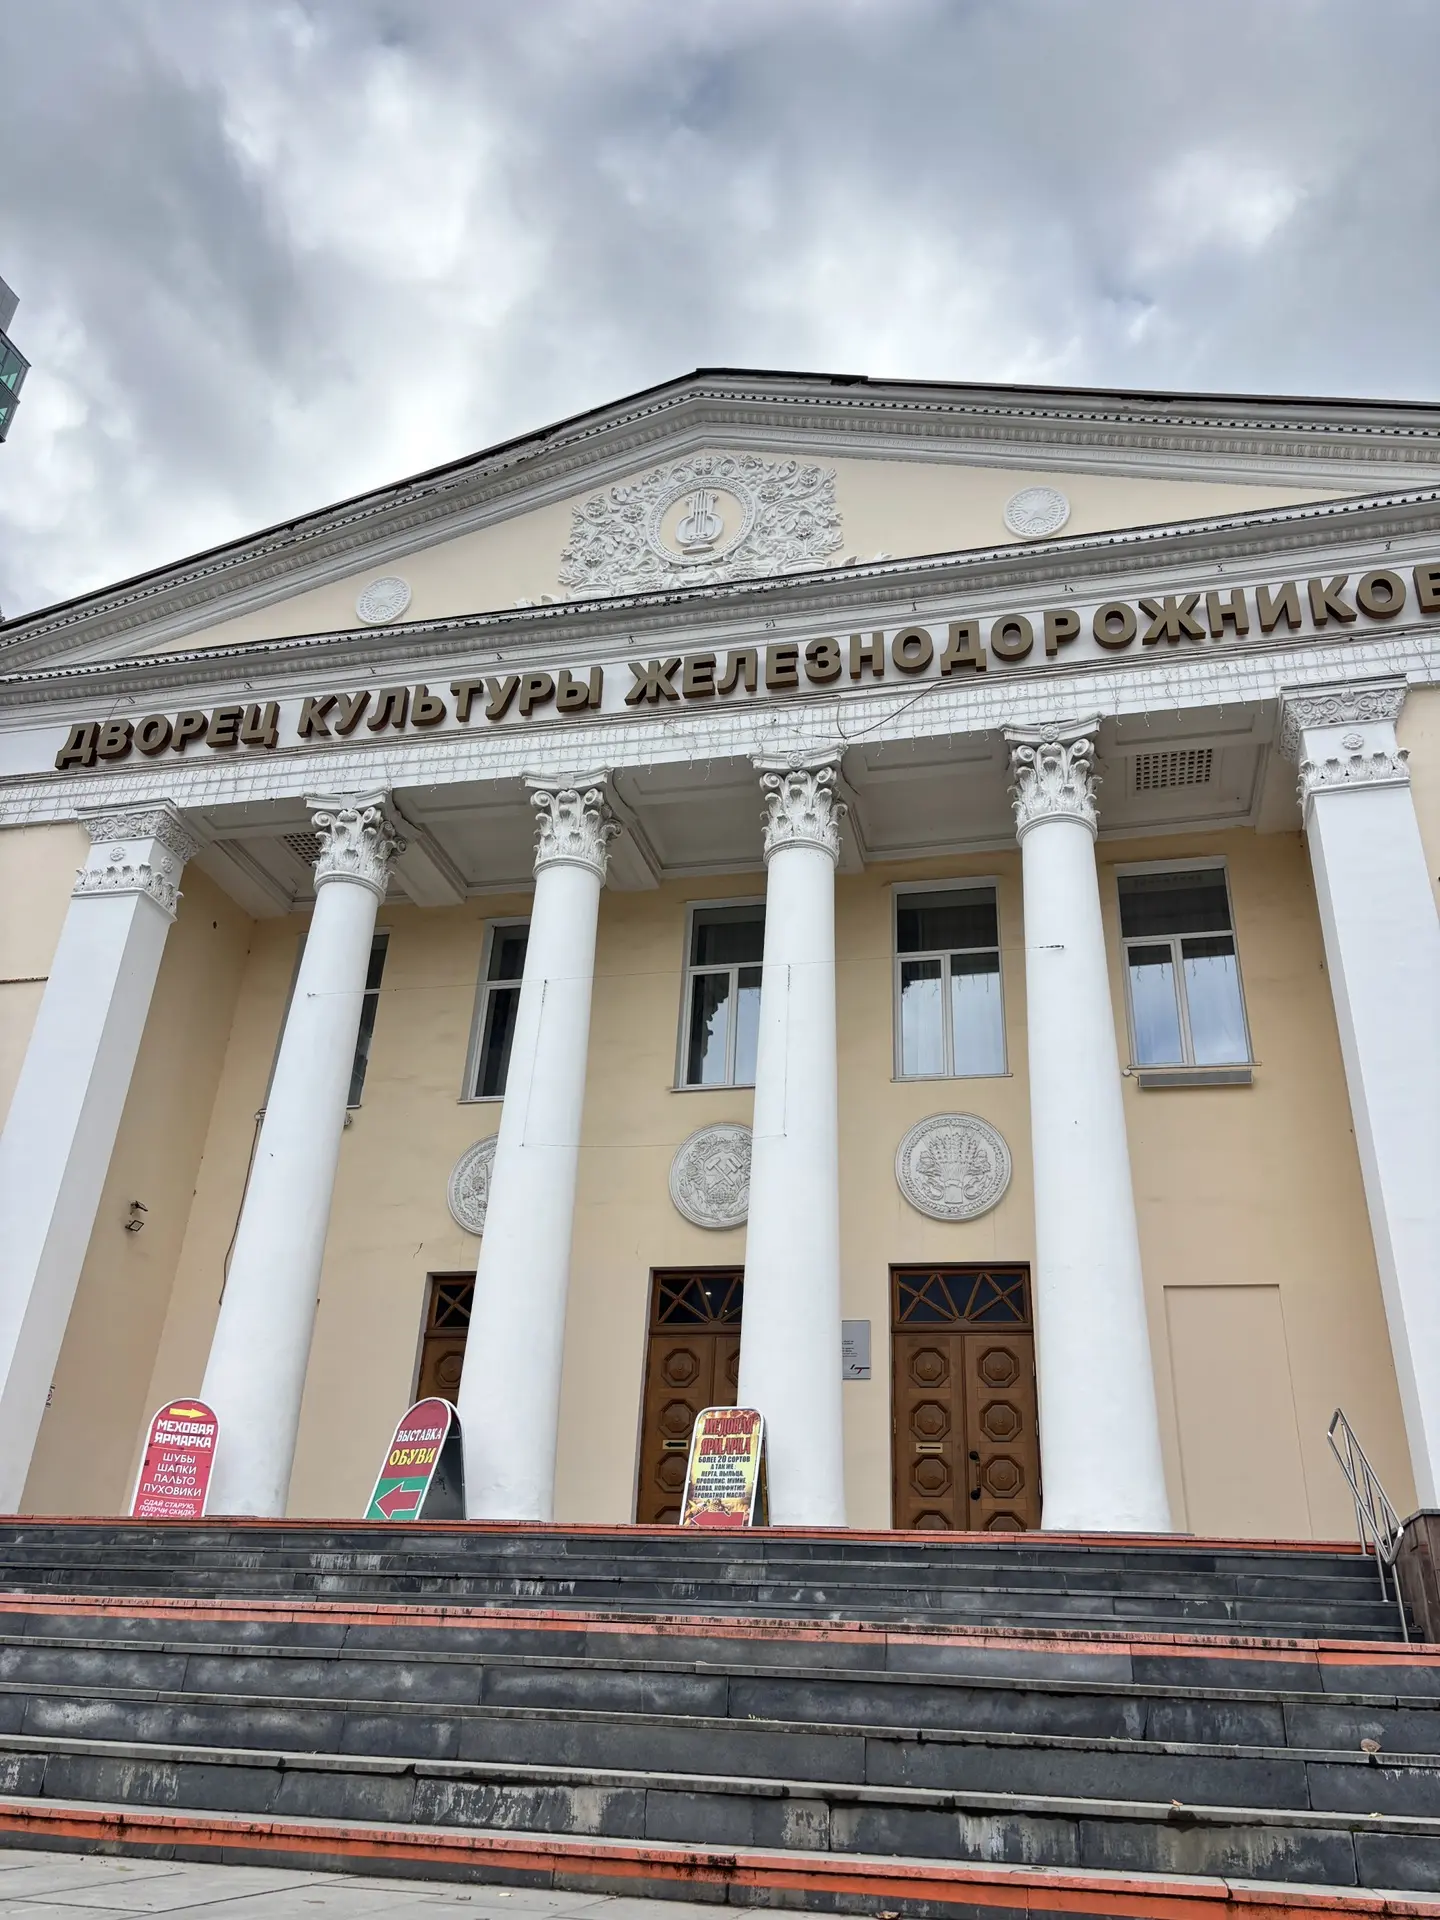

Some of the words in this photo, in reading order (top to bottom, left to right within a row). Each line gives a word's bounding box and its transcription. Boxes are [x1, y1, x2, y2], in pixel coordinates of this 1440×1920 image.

[54, 699, 280, 770] ДВОРЕЦ
[296, 665, 604, 738] КУЛЬТУРЫ
[157, 1419, 214, 1435] МЕХОВАЯ
[702, 1417, 755, 1437] МЕДОВАЯ
[154, 1432, 212, 1448] ЯРМАРКА
[396, 1427, 443, 1442] ВЫСТАВКА
[700, 1437, 751, 1455] ЯРМАРКА
[163, 1453, 196, 1464] ШУБЫ
[389, 1447, 437, 1466] ОБУВИ
[717, 1455, 727, 1463] 20
[157, 1463, 196, 1474] ШАПКИ
[153, 1474, 196, 1485] ПАЛЬТО
[143, 1483, 202, 1497] ПУХОВИКИ
[138, 1504, 168, 1514] ПОЛУЧИ
[168, 1508, 198, 1516] СКИДКУ
[143, 1499, 164, 1507] СДАЙ
